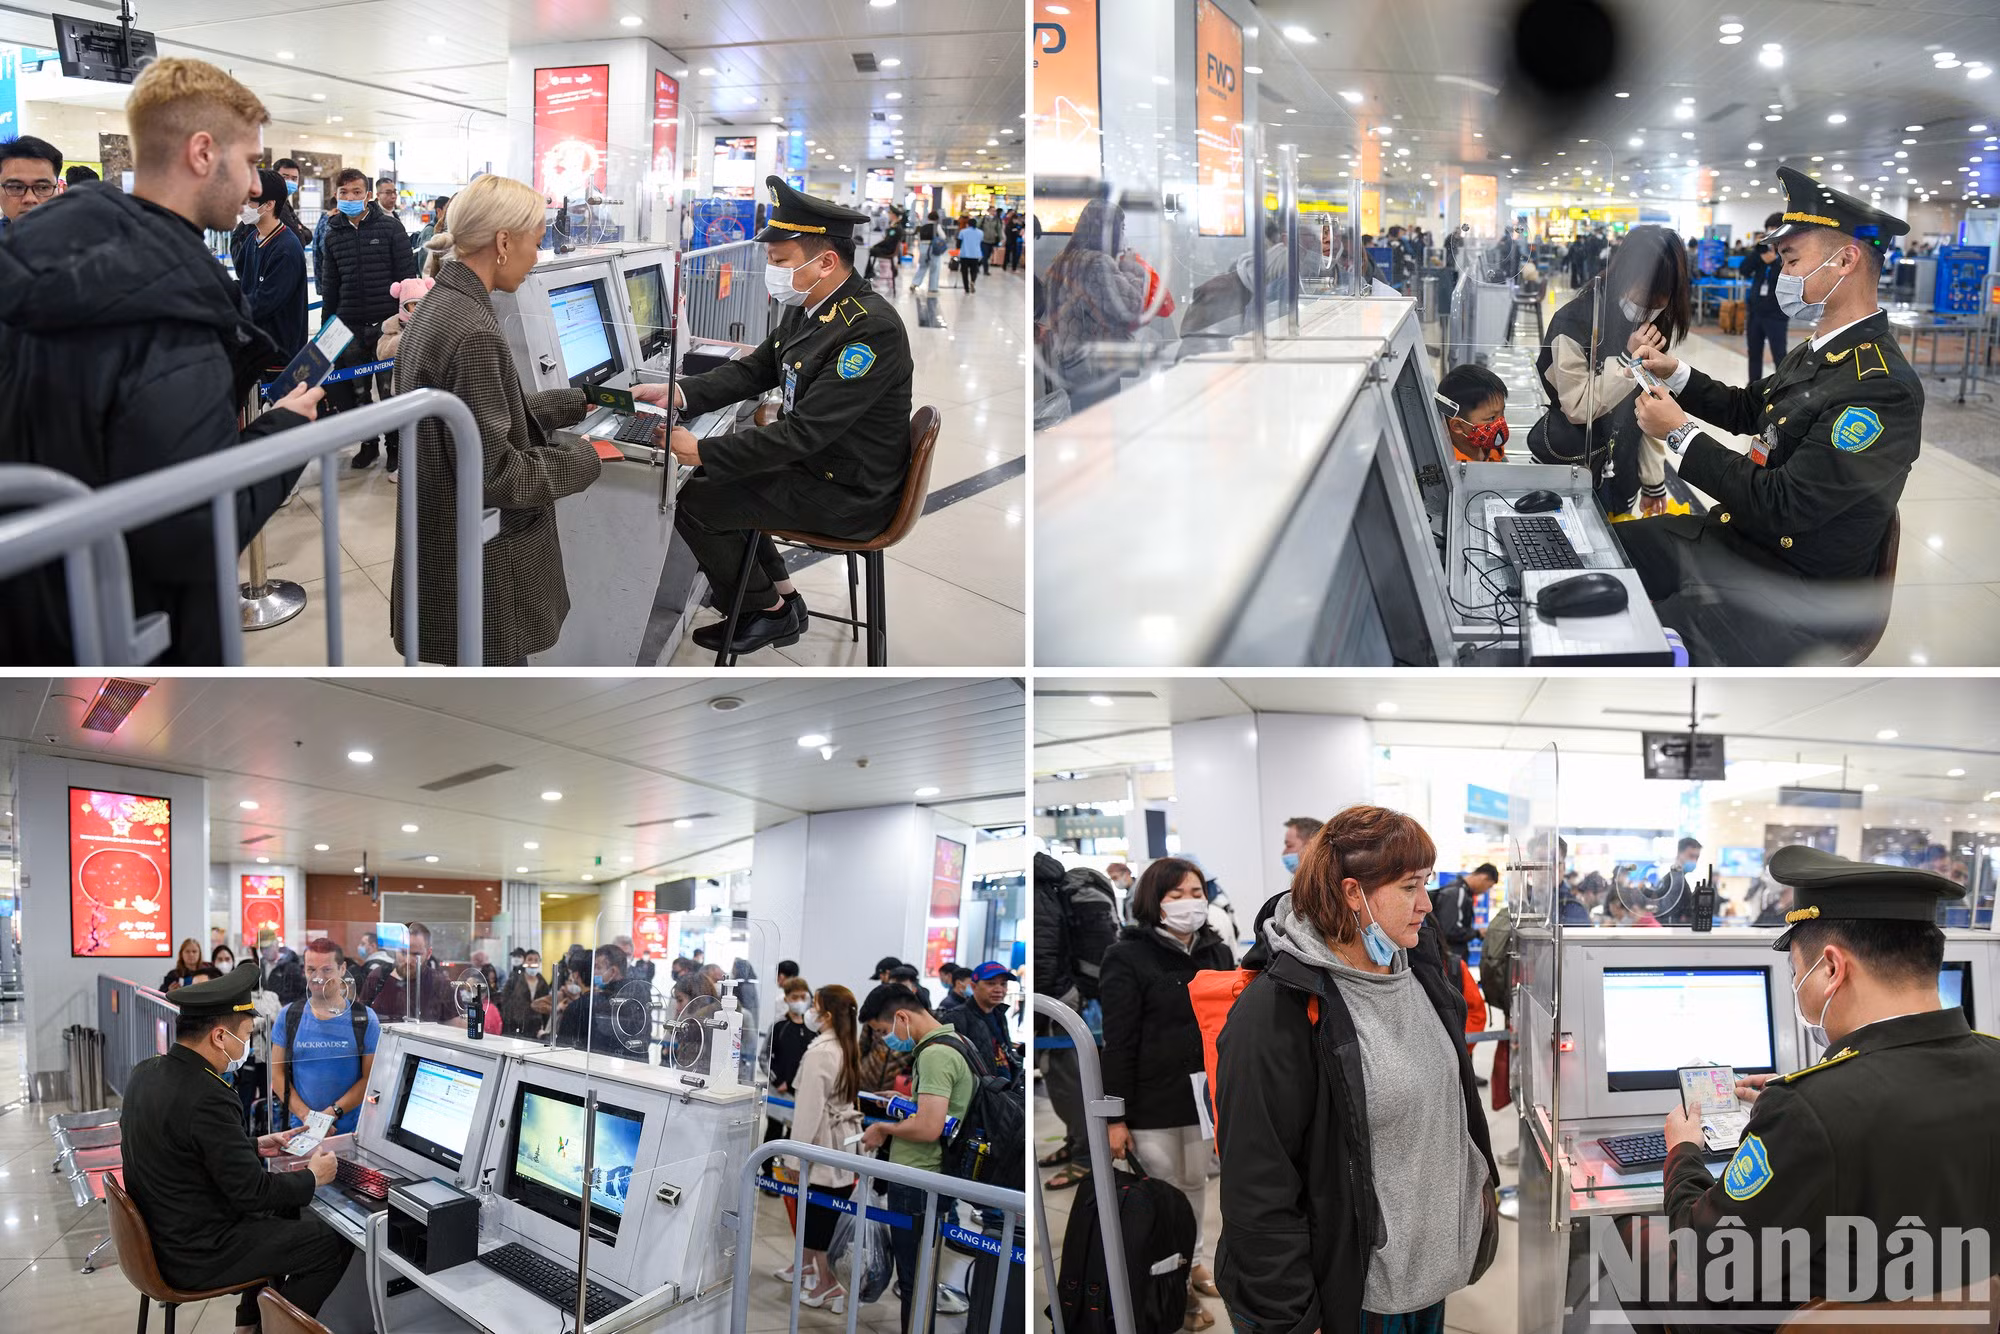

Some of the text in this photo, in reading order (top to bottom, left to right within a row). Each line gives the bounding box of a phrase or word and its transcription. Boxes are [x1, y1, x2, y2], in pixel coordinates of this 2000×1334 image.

[1207, 53, 1236, 92] FWD
[374, 360, 396, 371] INTERNA
[296, 1040, 342, 1049] BACKROADS
[832, 1199, 852, 1211] N.I.A
